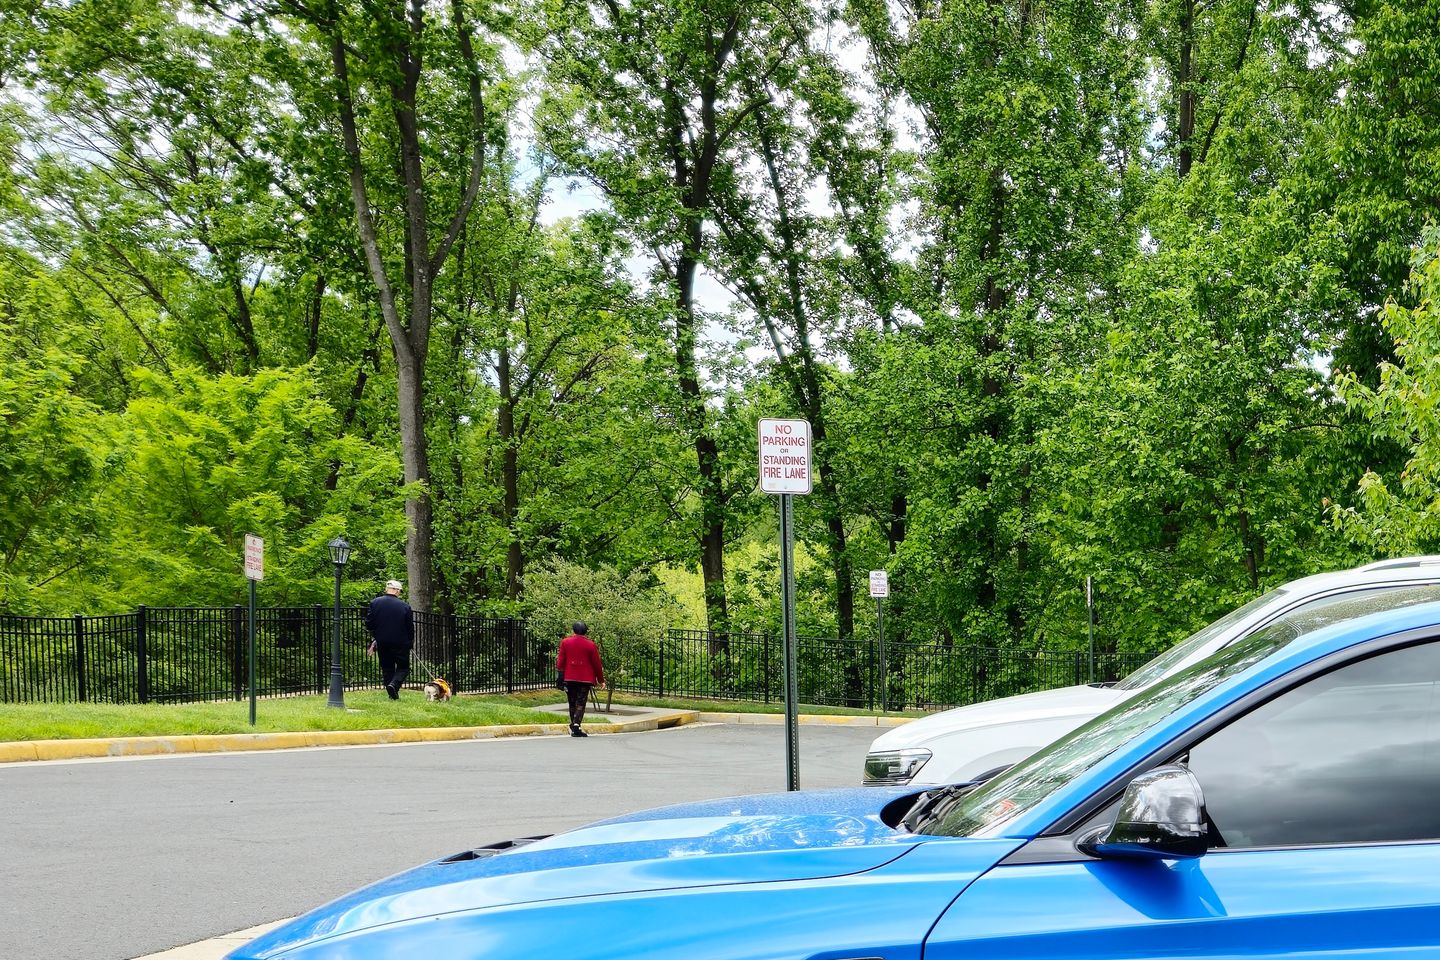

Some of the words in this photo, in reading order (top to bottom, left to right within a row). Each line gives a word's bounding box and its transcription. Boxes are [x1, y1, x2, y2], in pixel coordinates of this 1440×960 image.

[775, 425, 792, 434] NO
[762, 436, 805, 446] PARKING
[763, 455, 806, 465] STANDING
[763, 467, 781, 478] FIRE
[785, 468, 806, 479] LANE
